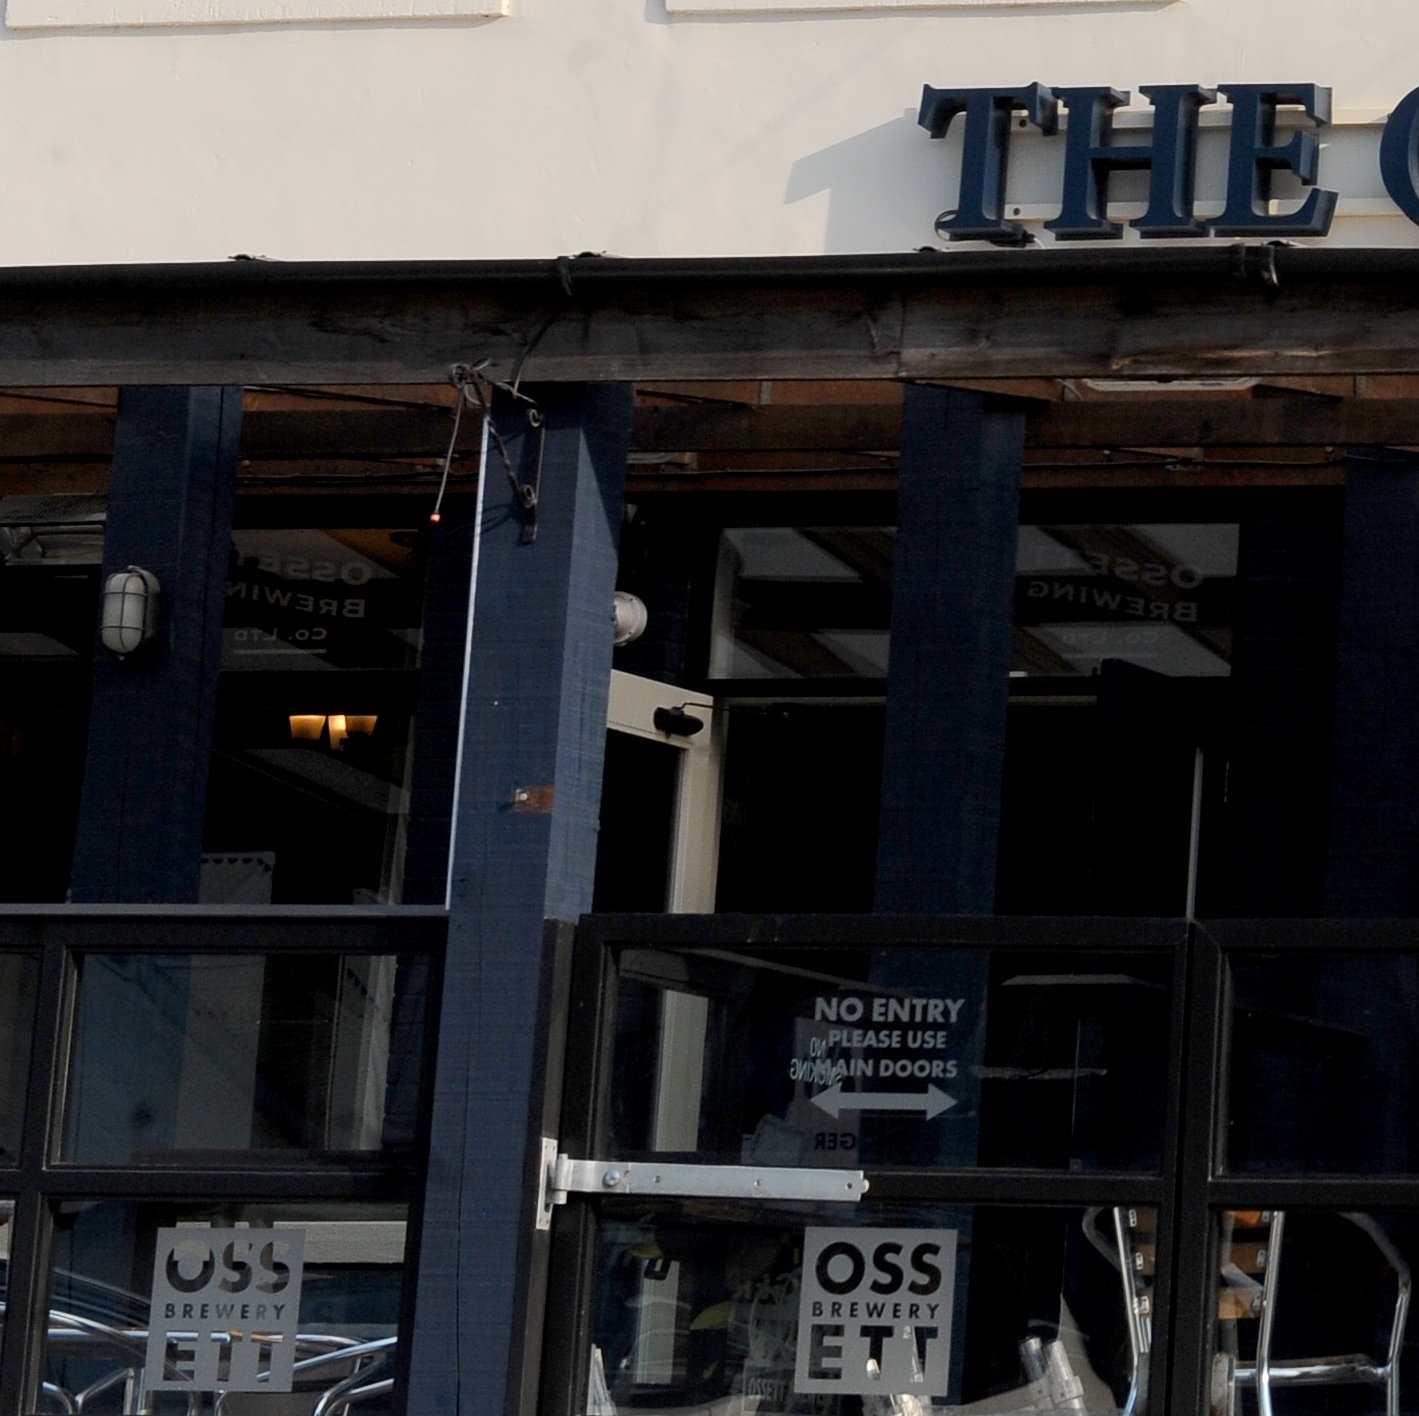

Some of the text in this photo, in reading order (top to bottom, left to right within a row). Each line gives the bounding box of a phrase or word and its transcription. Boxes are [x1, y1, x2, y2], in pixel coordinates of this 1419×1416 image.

[916, 81, 1338, 241] THE
[814, 996, 966, 1023] NO ENTRY
[829, 1029, 948, 1049] PLEASE USE
[879, 1059, 958, 1078] DOORS
[166, 1240, 291, 1293] OSS
[815, 1241, 942, 1295] OSS
[165, 1303, 286, 1319] BREWERY
[812, 1301, 940, 1319] BREWERY
[163, 1330, 284, 1382] ETT
[808, 1324, 939, 1383] ETT
